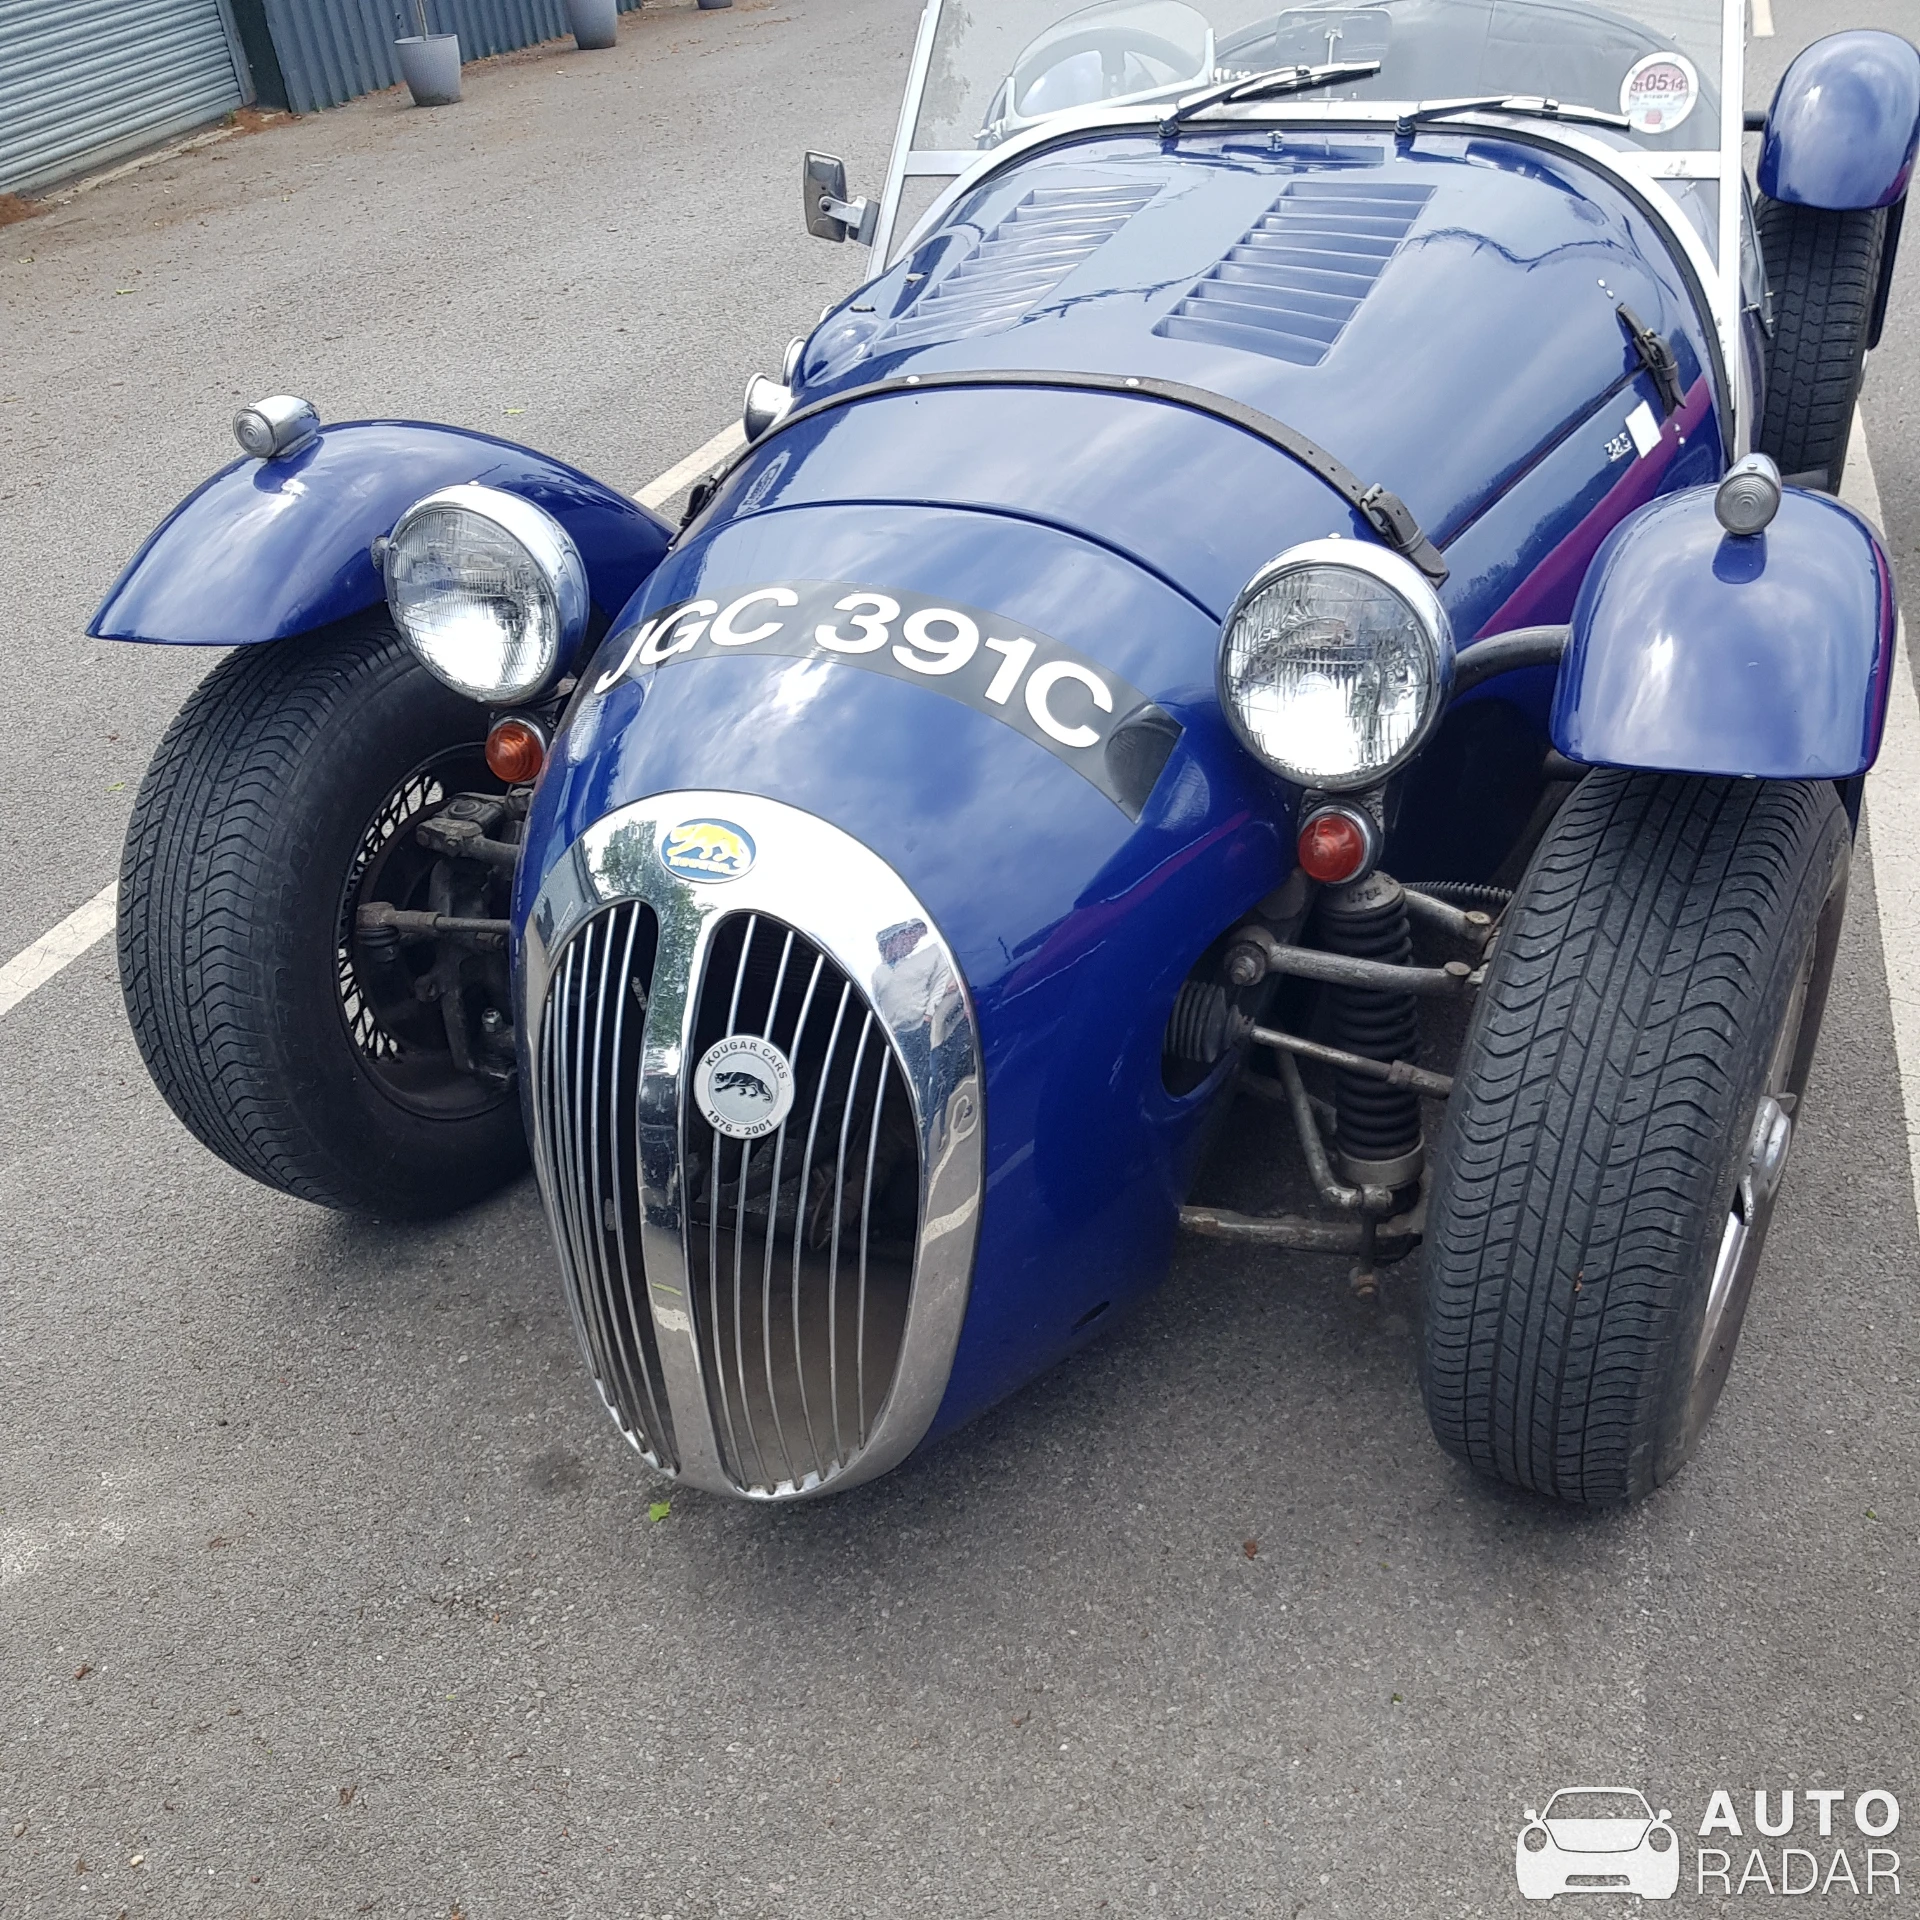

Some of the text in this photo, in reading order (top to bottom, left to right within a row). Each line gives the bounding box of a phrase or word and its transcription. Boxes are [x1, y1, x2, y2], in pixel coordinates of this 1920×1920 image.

[1646, 74, 1668, 91] 05
[1669, 78, 1684, 91] 14
[594, 587, 1113, 748] JGC 391C
[705, 1041, 788, 1079] KOUGAR CARS
[707, 1110, 733, 1133] 1976
[744, 1119, 773, 1135] 2001
